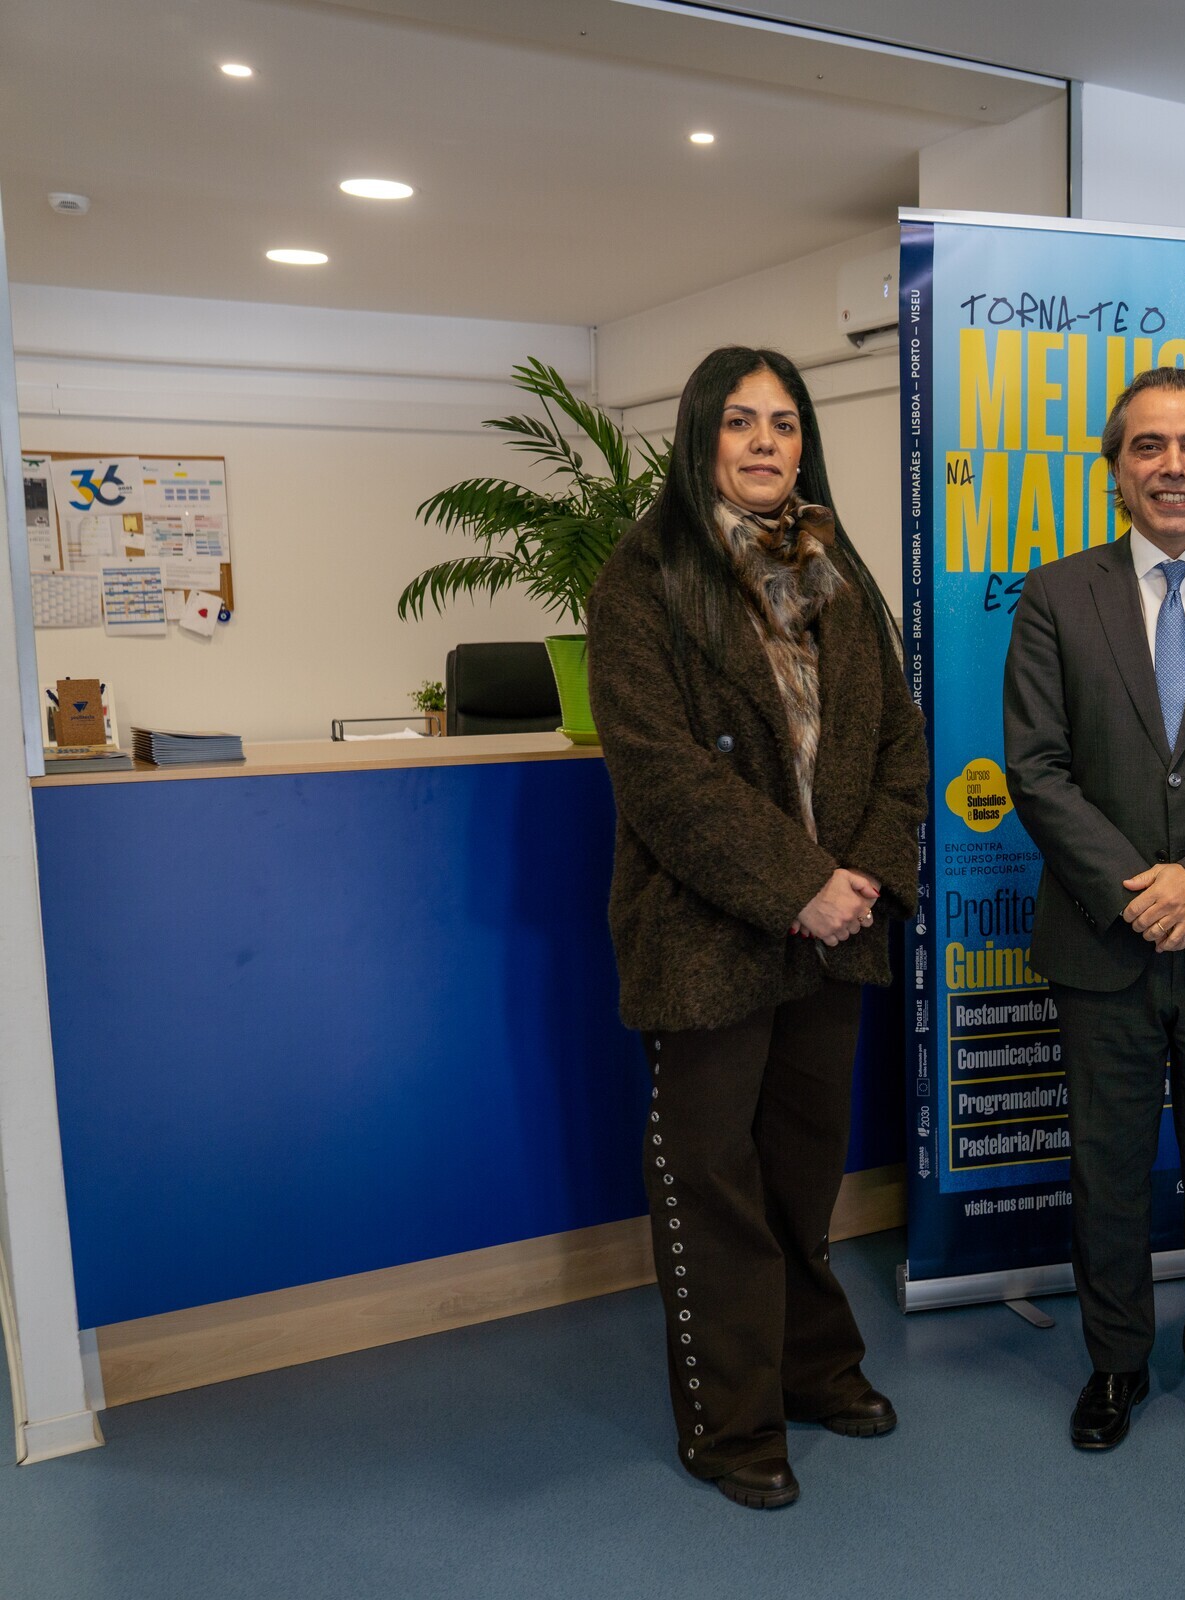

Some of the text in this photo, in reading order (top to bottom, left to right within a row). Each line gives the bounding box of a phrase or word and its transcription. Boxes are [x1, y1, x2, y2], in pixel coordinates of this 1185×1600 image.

[911, 289, 920, 323] VISEU
[960, 292, 1166, 334] TORNA-TE O
[911, 338, 920, 378] PORTO
[911, 393, 920, 435] LISBOA
[910, 451, 921, 517] GUIMARÃES
[946, 458, 975, 485] NA
[912, 532, 921, 585] COIMBRA
[913, 601, 922, 639] BRAGA
[966, 769, 990, 781] Cursos
[967, 784, 981, 794] com
[967, 794, 1006, 807] Subsídios
[968, 809, 1000, 820] e Bolsas
[945, 842, 1003, 852] ENCONTRA
[945, 855, 953, 864] O
[957, 854, 993, 864] CURSO
[945, 864, 1026, 876] QUE PROCURAS
[946, 940, 1048, 989] Guima
[958, 1042, 1061, 1069] Comunicação e
[920, 1106, 930, 1128] 2030
[959, 1128, 1071, 1158] Pastelaria/Pada
[965, 1199, 1016, 1216] visita-nos
[1018, 1195, 1034, 1210] em
